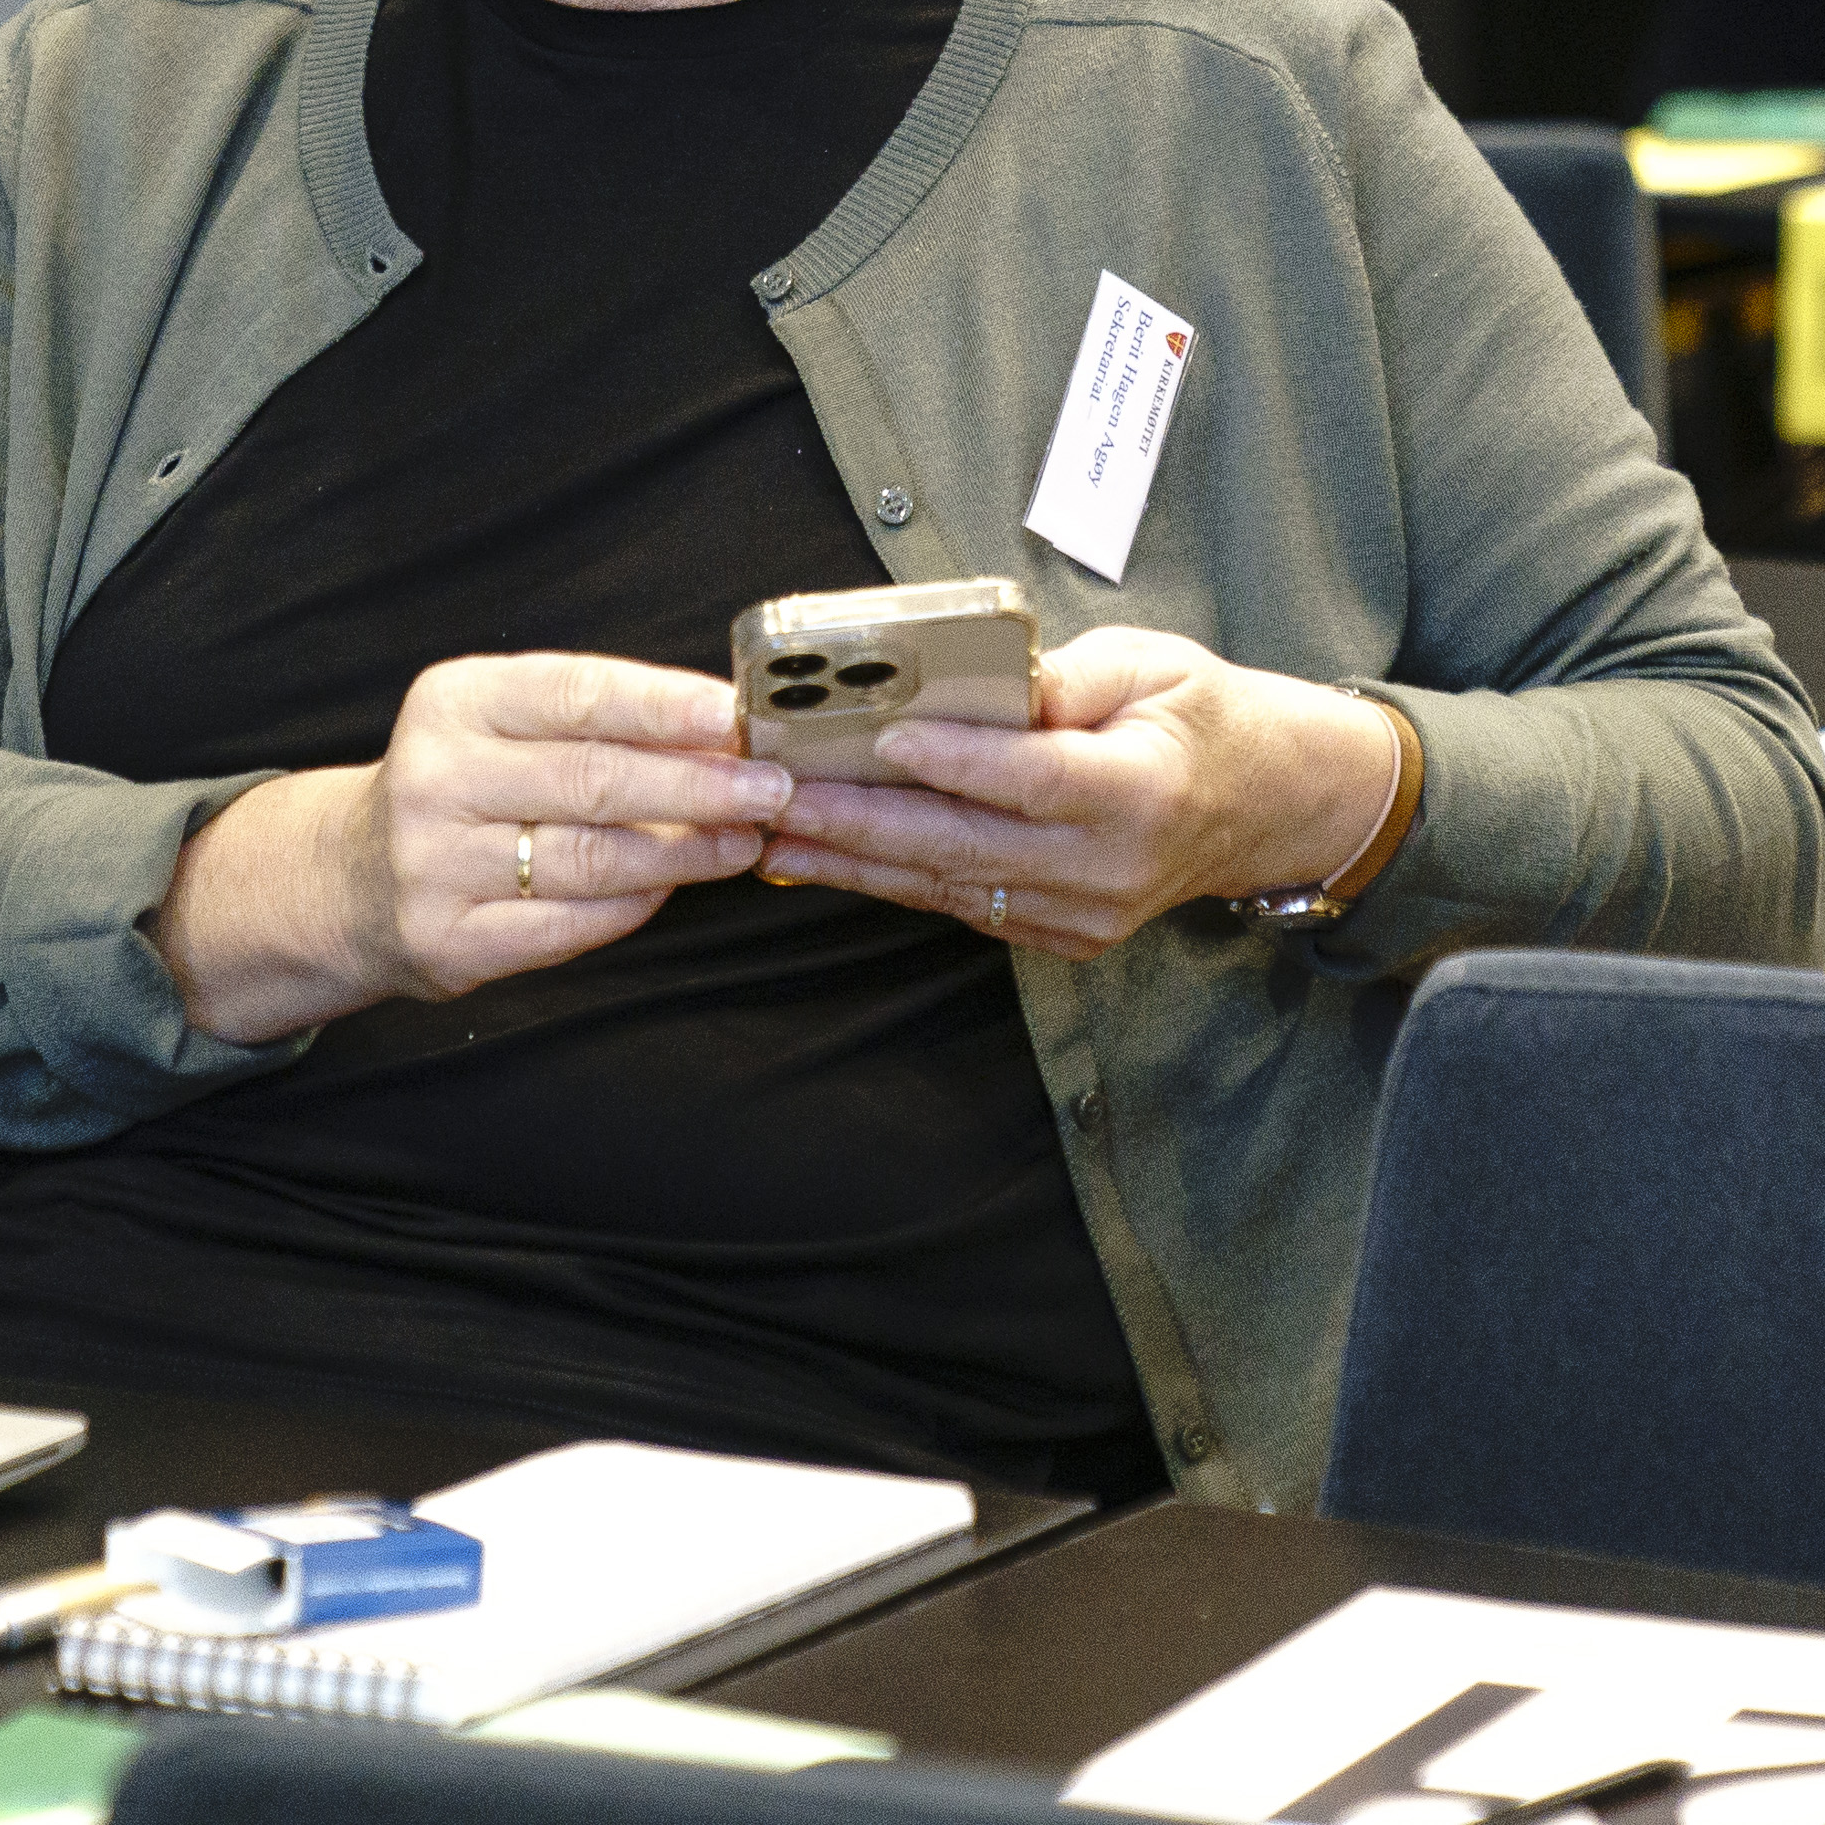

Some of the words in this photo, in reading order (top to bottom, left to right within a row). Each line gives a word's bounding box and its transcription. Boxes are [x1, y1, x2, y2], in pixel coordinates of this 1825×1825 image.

[1089, 295, 1132, 403] Sekretariat
[1129, 309, 1154, 361] Berit
[1107, 364, 1138, 428] Hagen
[1138, 358, 1174, 458] KIRKEMØTET
[1088, 433, 1116, 489] Agøy
